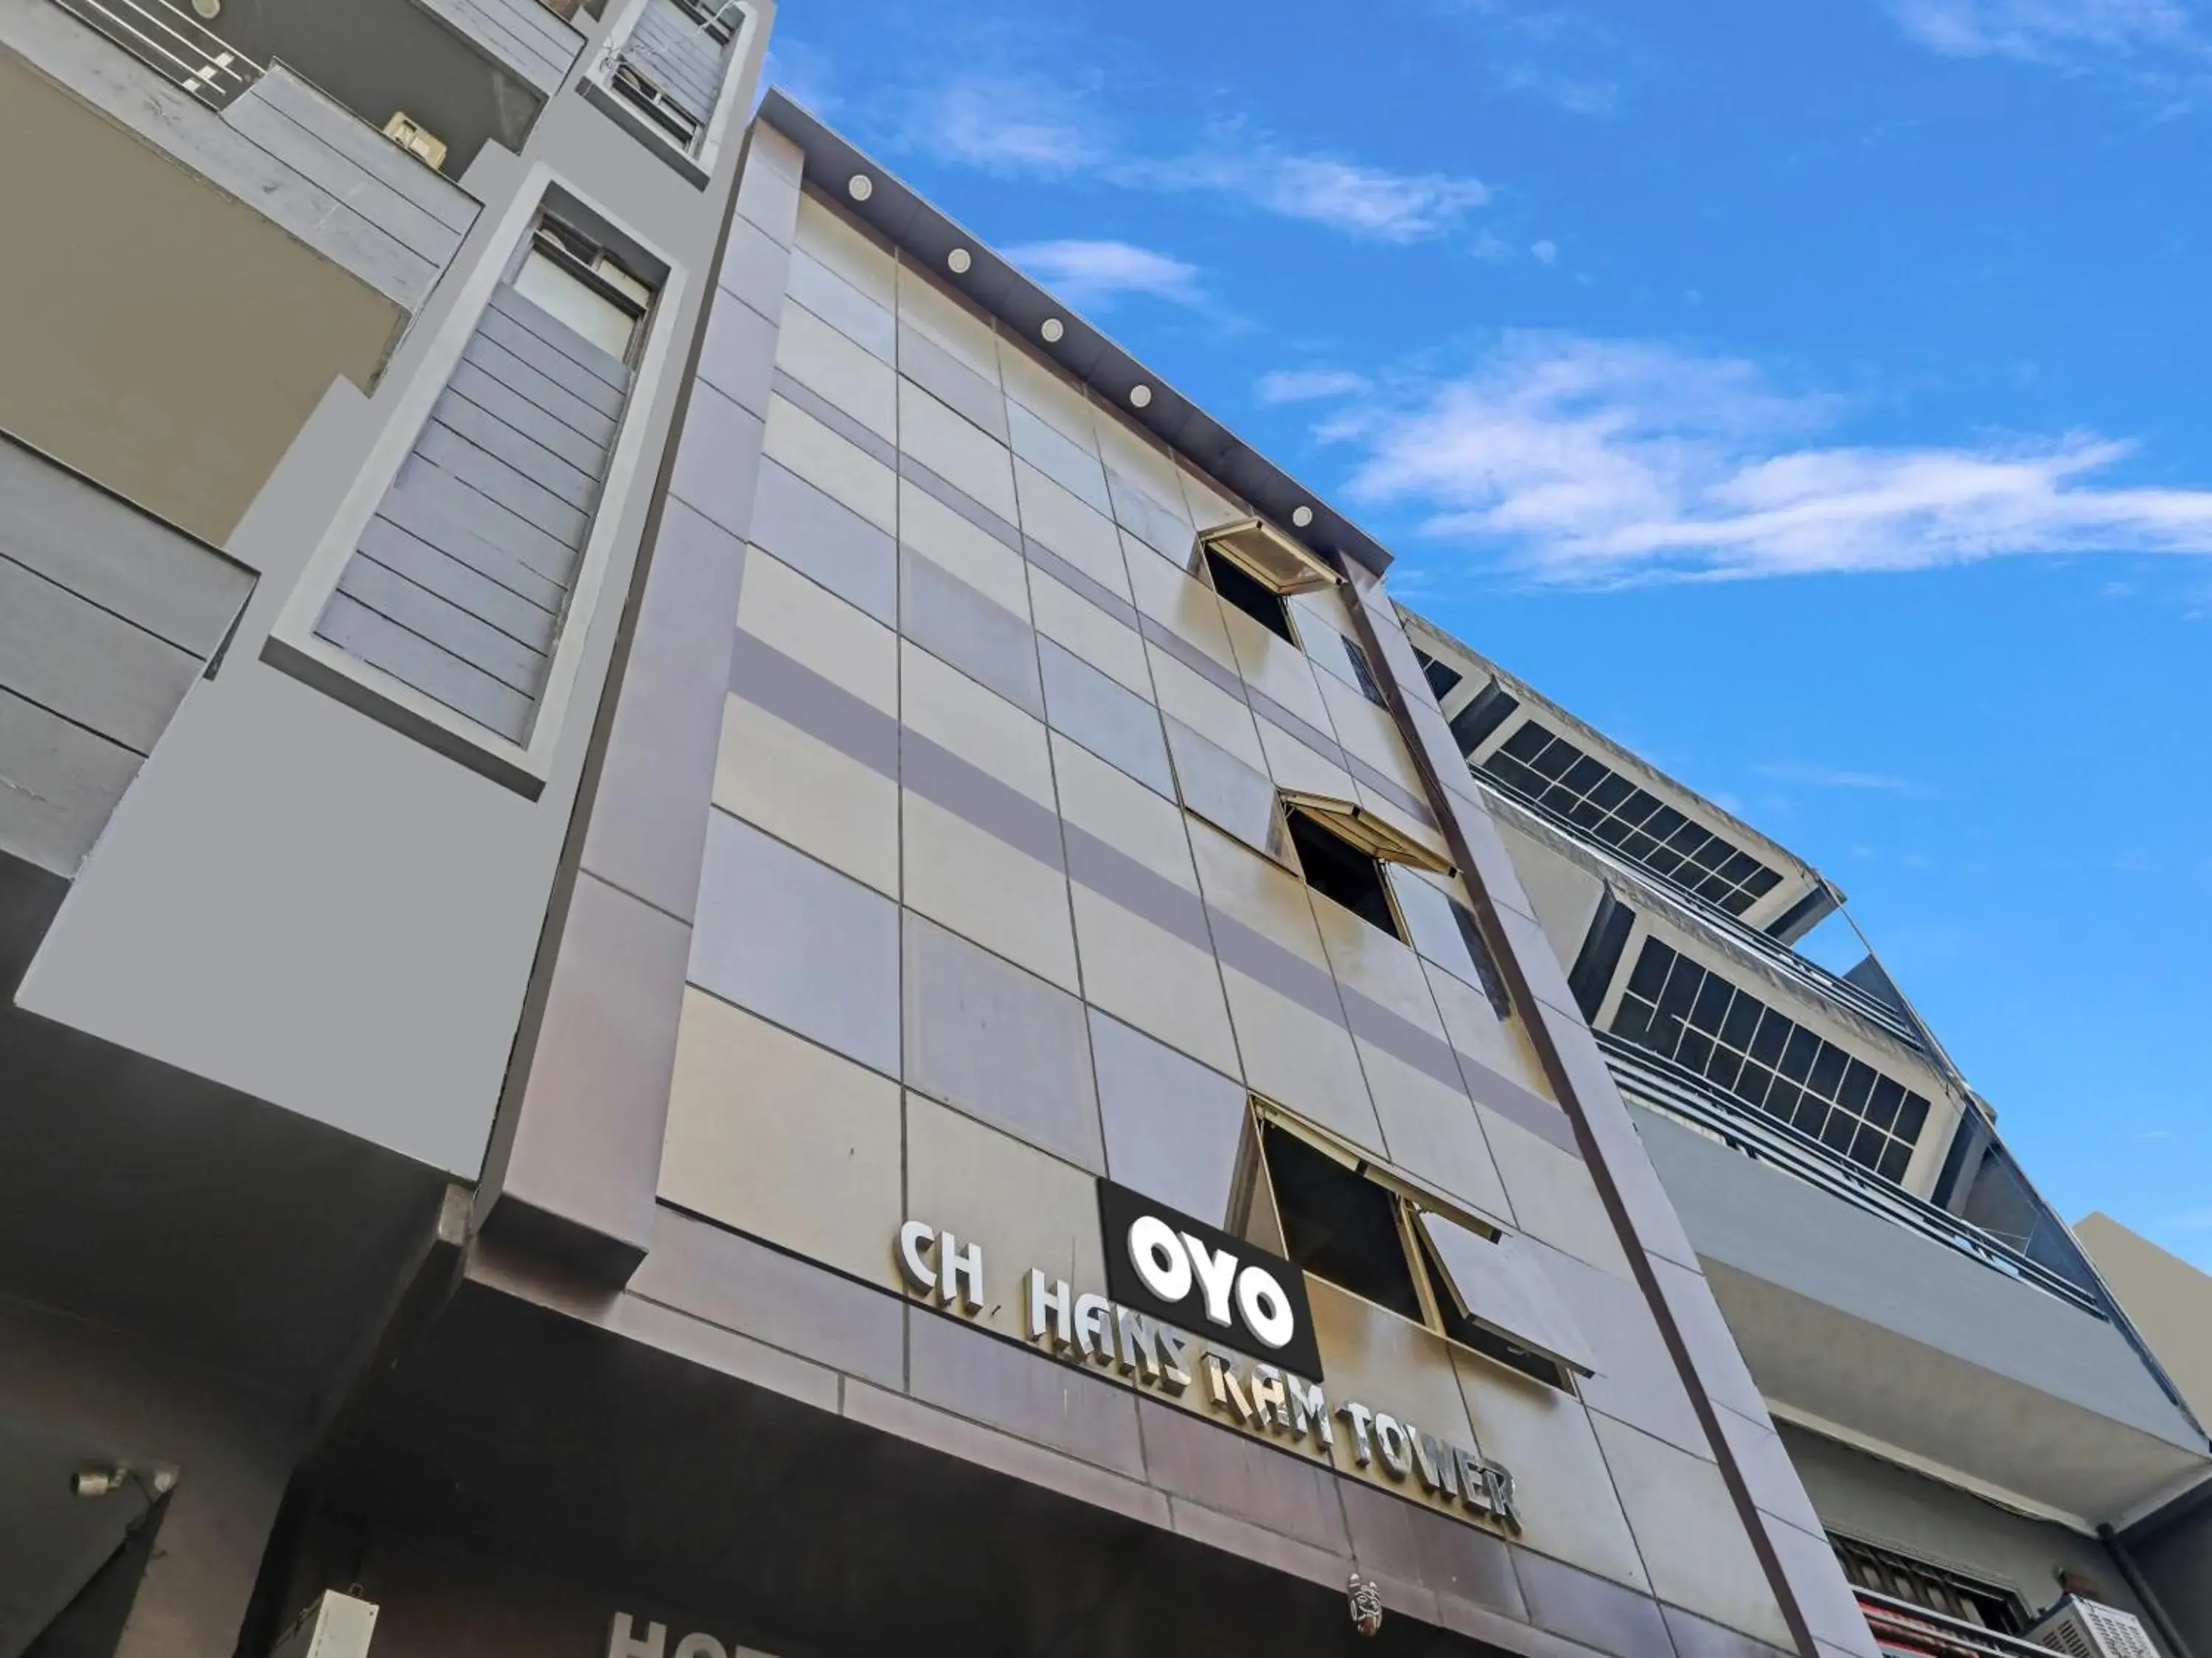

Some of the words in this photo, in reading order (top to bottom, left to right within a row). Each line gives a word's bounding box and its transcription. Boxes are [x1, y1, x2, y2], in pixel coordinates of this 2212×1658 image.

[1127, 1215, 1295, 1350] OYO
[1202, 1339, 1334, 1450] RAM
[1336, 1401, 1523, 1536] TOWER
